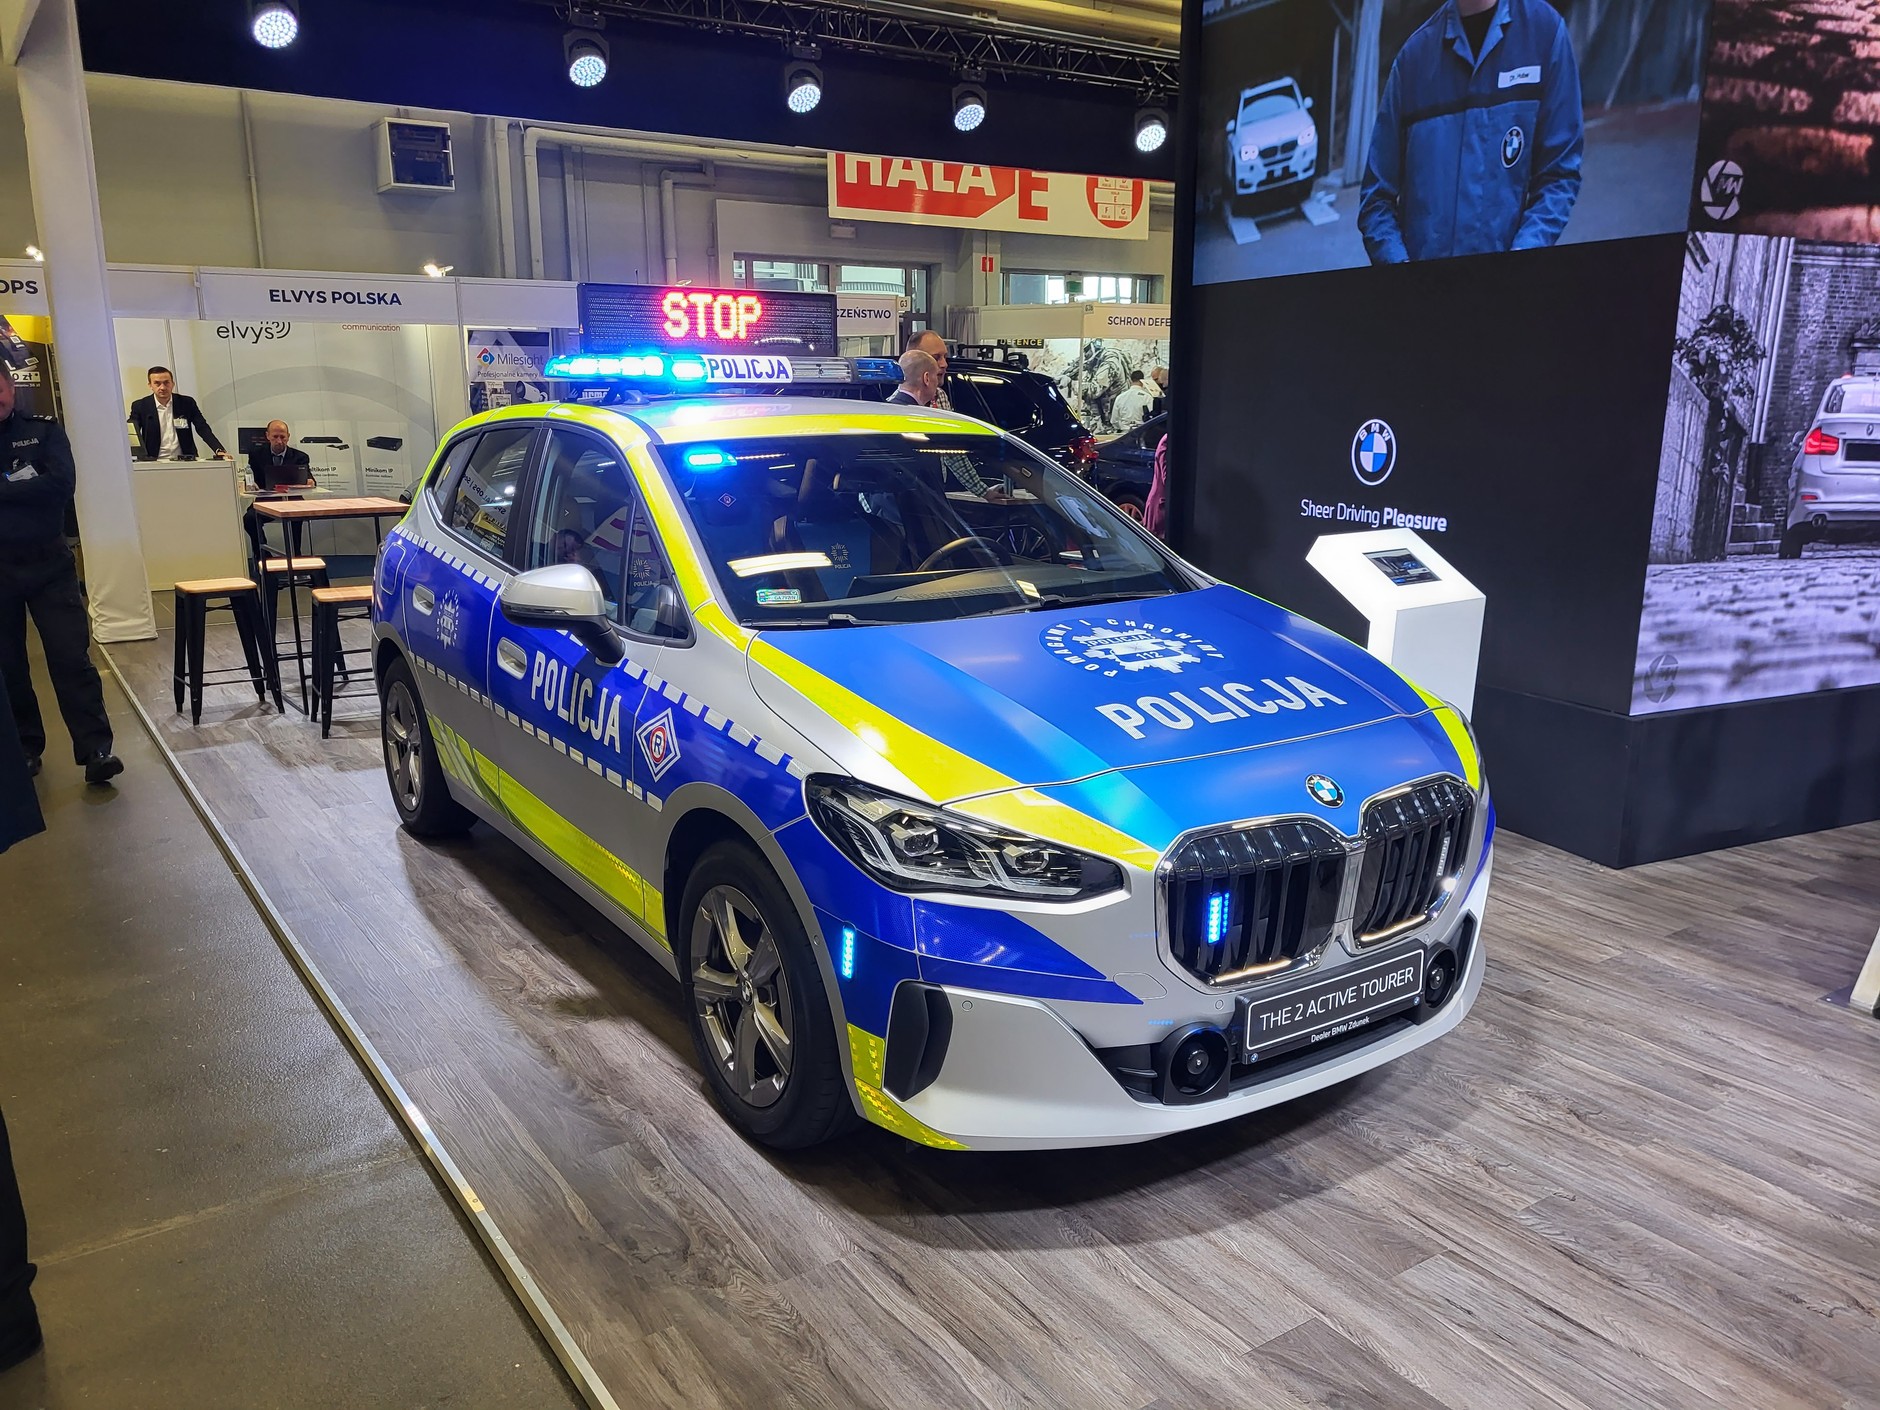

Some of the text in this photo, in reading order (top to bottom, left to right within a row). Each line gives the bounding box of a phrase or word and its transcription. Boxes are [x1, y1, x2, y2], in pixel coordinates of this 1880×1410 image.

[269, 288, 402, 306] ELVYS POLSKA
[662, 291, 761, 339] STOP
[1107, 316, 1146, 326] SCHRON
[341, 322, 401, 332] communication
[497, 353, 544, 368] Milesight
[710, 358, 790, 379] POLICJA
[1359, 422, 1391, 441] BMW
[12, 437, 39, 448] POLICJA
[1300, 499, 1448, 532] Sheer Driving Pleasure
[1090, 633, 1149, 646] POLICJA
[1136, 651, 1164, 660] 112
[531, 650, 622, 754] POLICJA
[1095, 676, 1348, 740] POLICJA
[653, 734, 662, 756] R
[1260, 966, 1414, 1030] THE 2 ACTIVE TOURER
[1311, 1016, 1370, 1043] Dealer BMW Zdunek
